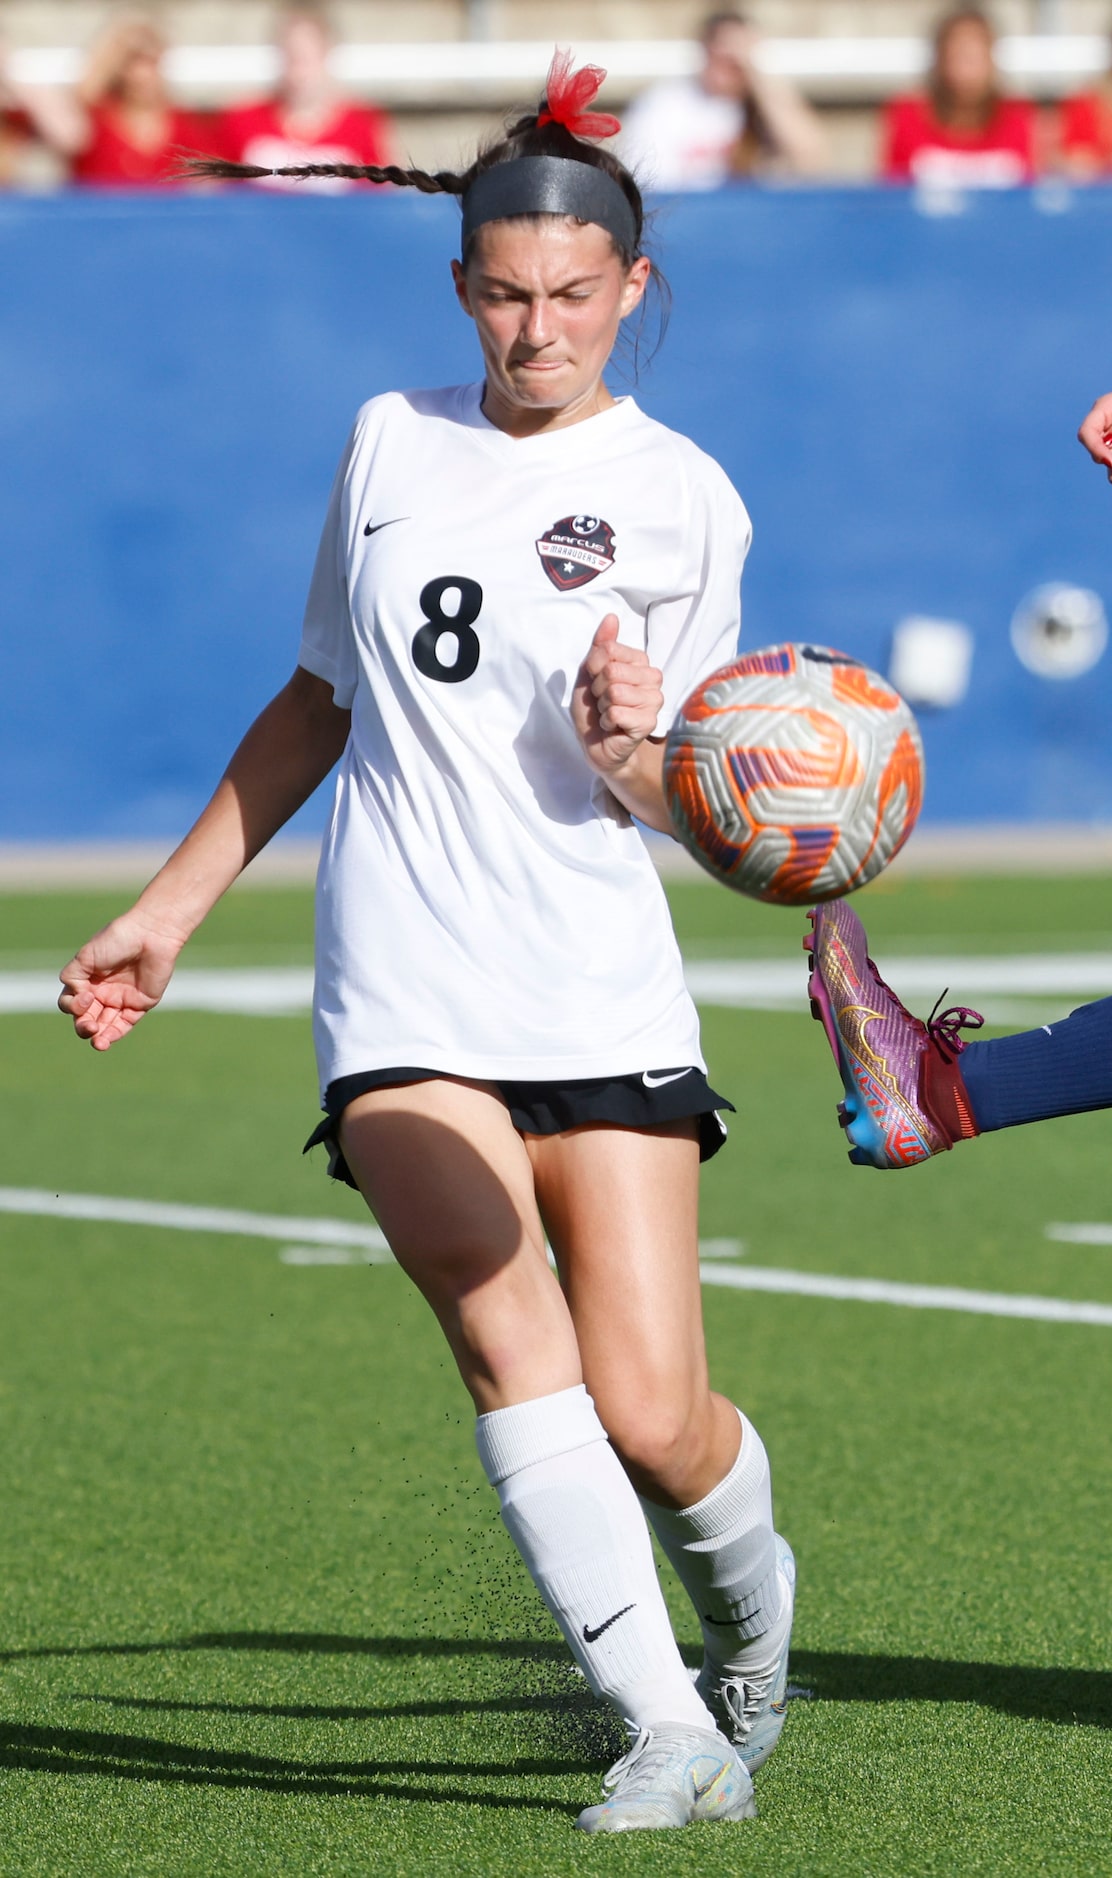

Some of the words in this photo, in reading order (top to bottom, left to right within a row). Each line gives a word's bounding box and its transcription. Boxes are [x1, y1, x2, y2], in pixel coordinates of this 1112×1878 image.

[551, 534, 606, 553] MARCUS
[550, 545, 598, 565] MARAUDERS
[411, 575, 483, 684] 8
